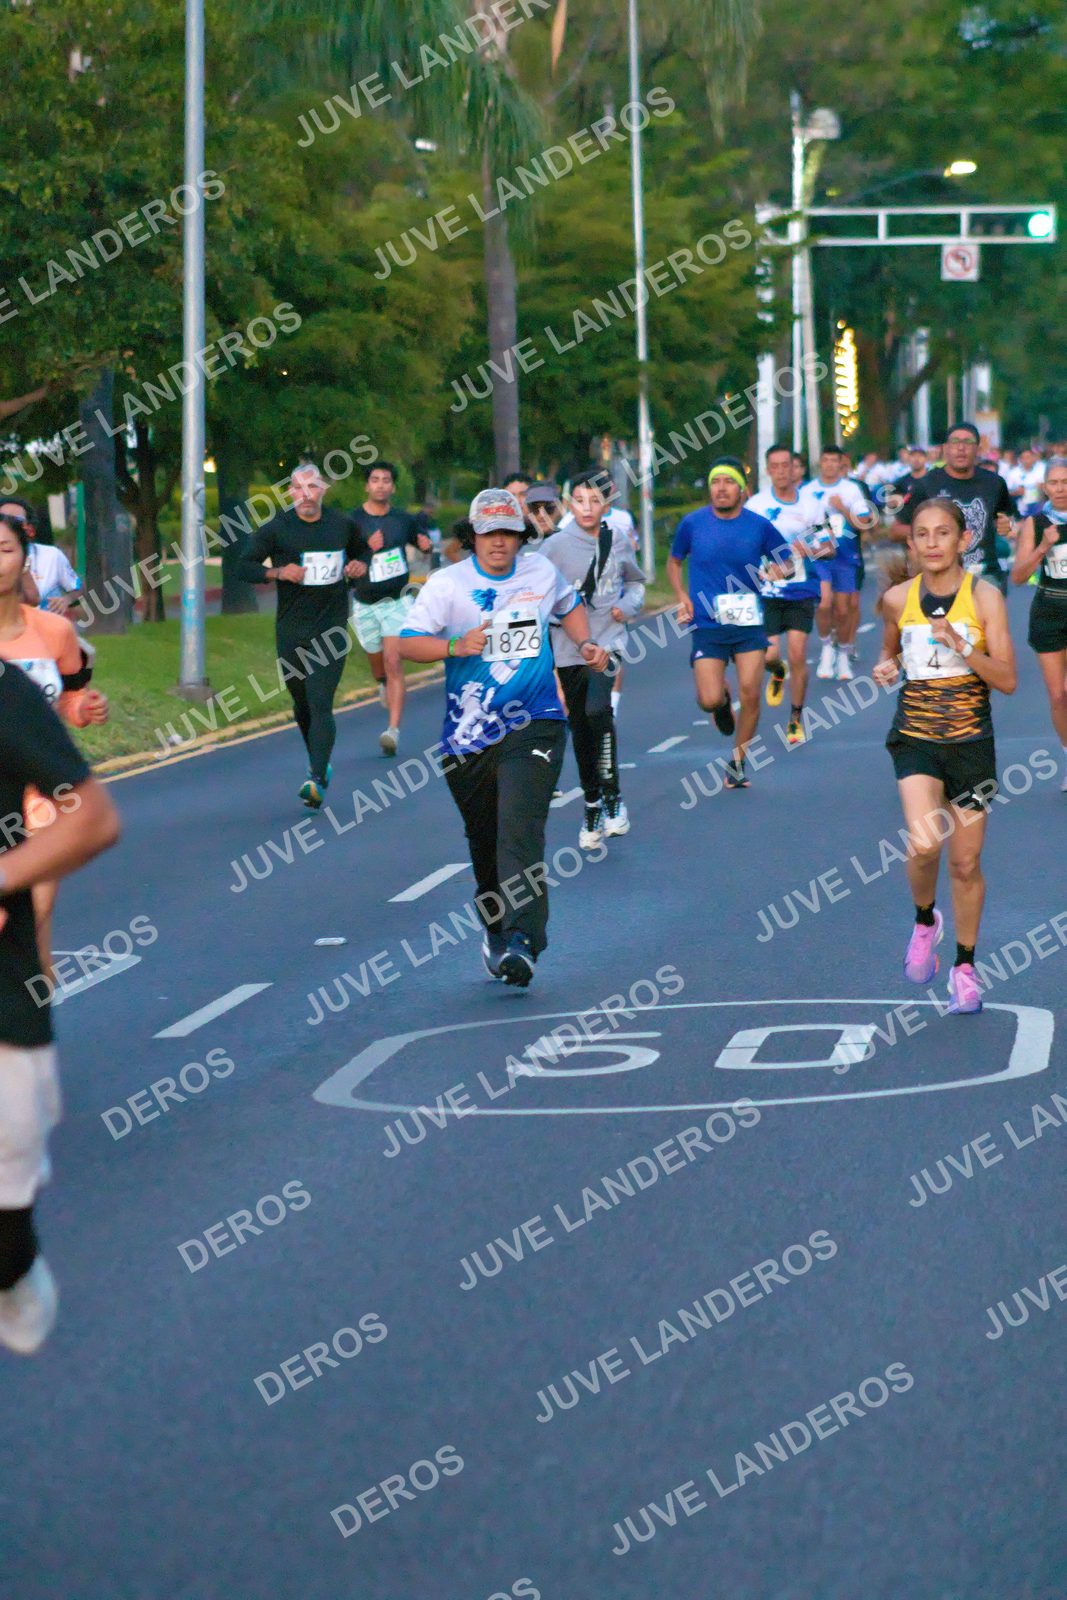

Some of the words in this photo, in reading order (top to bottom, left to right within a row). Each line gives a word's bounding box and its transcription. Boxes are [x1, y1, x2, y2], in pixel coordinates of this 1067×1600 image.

[726, 607, 754, 621] 875
[486, 628, 541, 655] 1826
[927, 649, 941, 670] 4
[507, 1023, 877, 1078] 50
